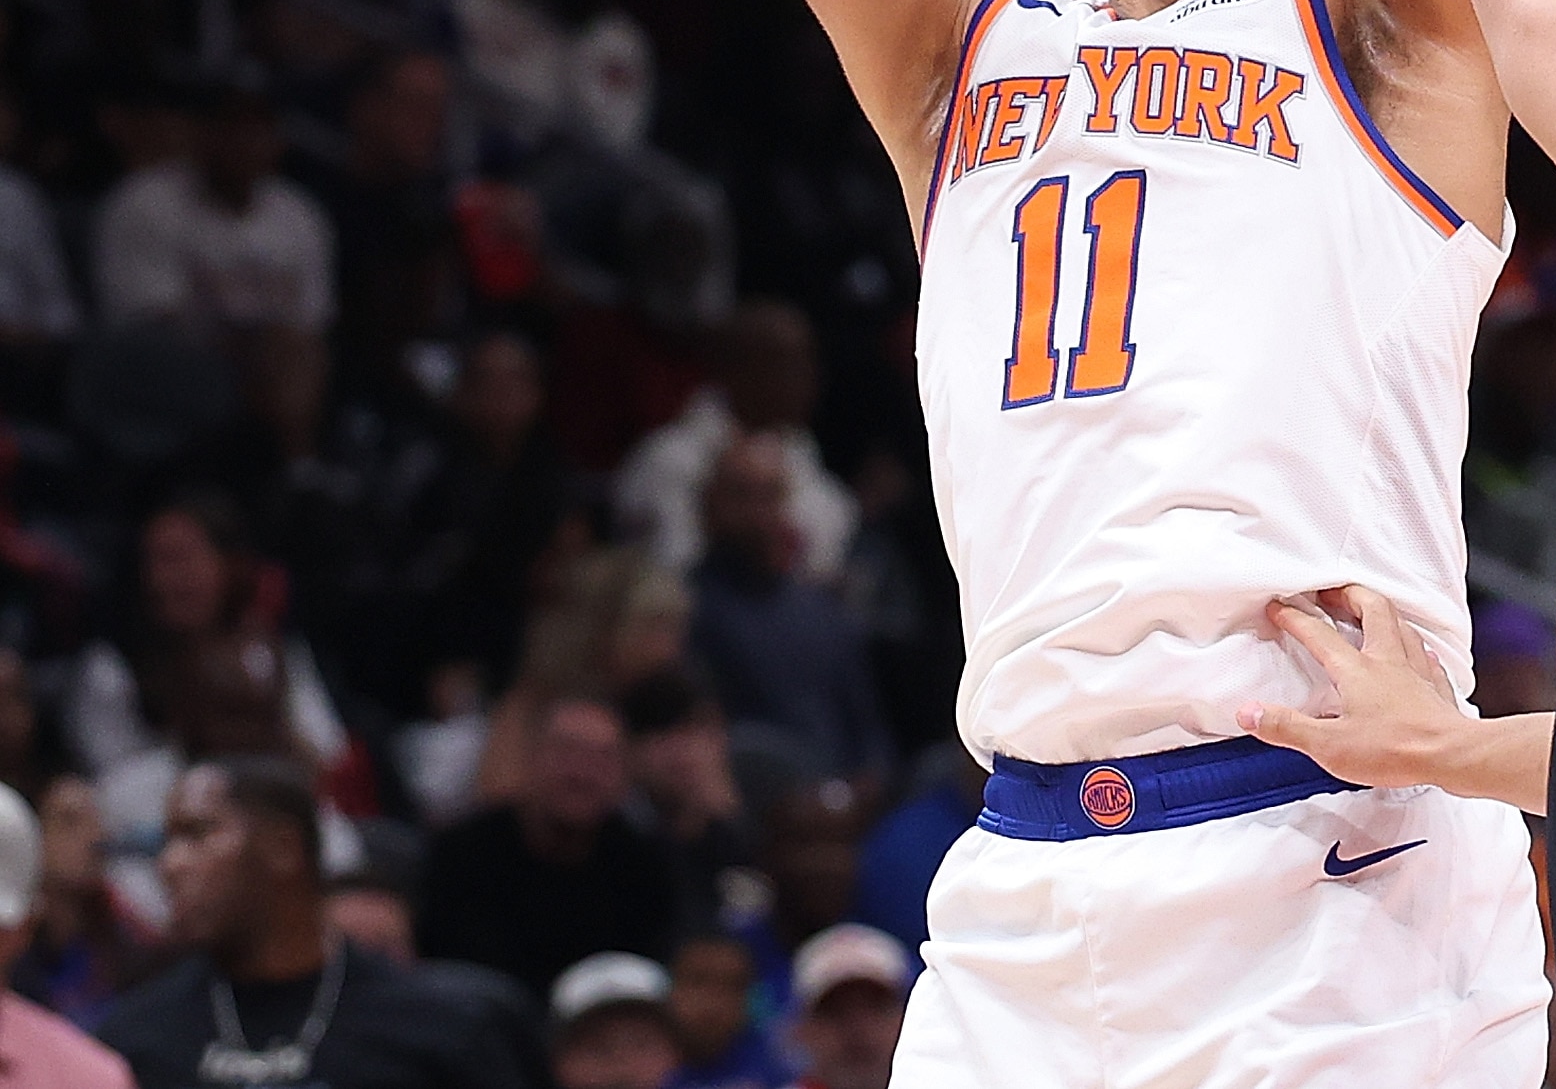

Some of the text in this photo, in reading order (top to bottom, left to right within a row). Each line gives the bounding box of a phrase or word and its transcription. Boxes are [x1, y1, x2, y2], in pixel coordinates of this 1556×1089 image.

[1077, 45, 1306, 167] YORK
[1001, 169, 1147, 411] 11
[1086, 785, 1127, 812] KNICKS
